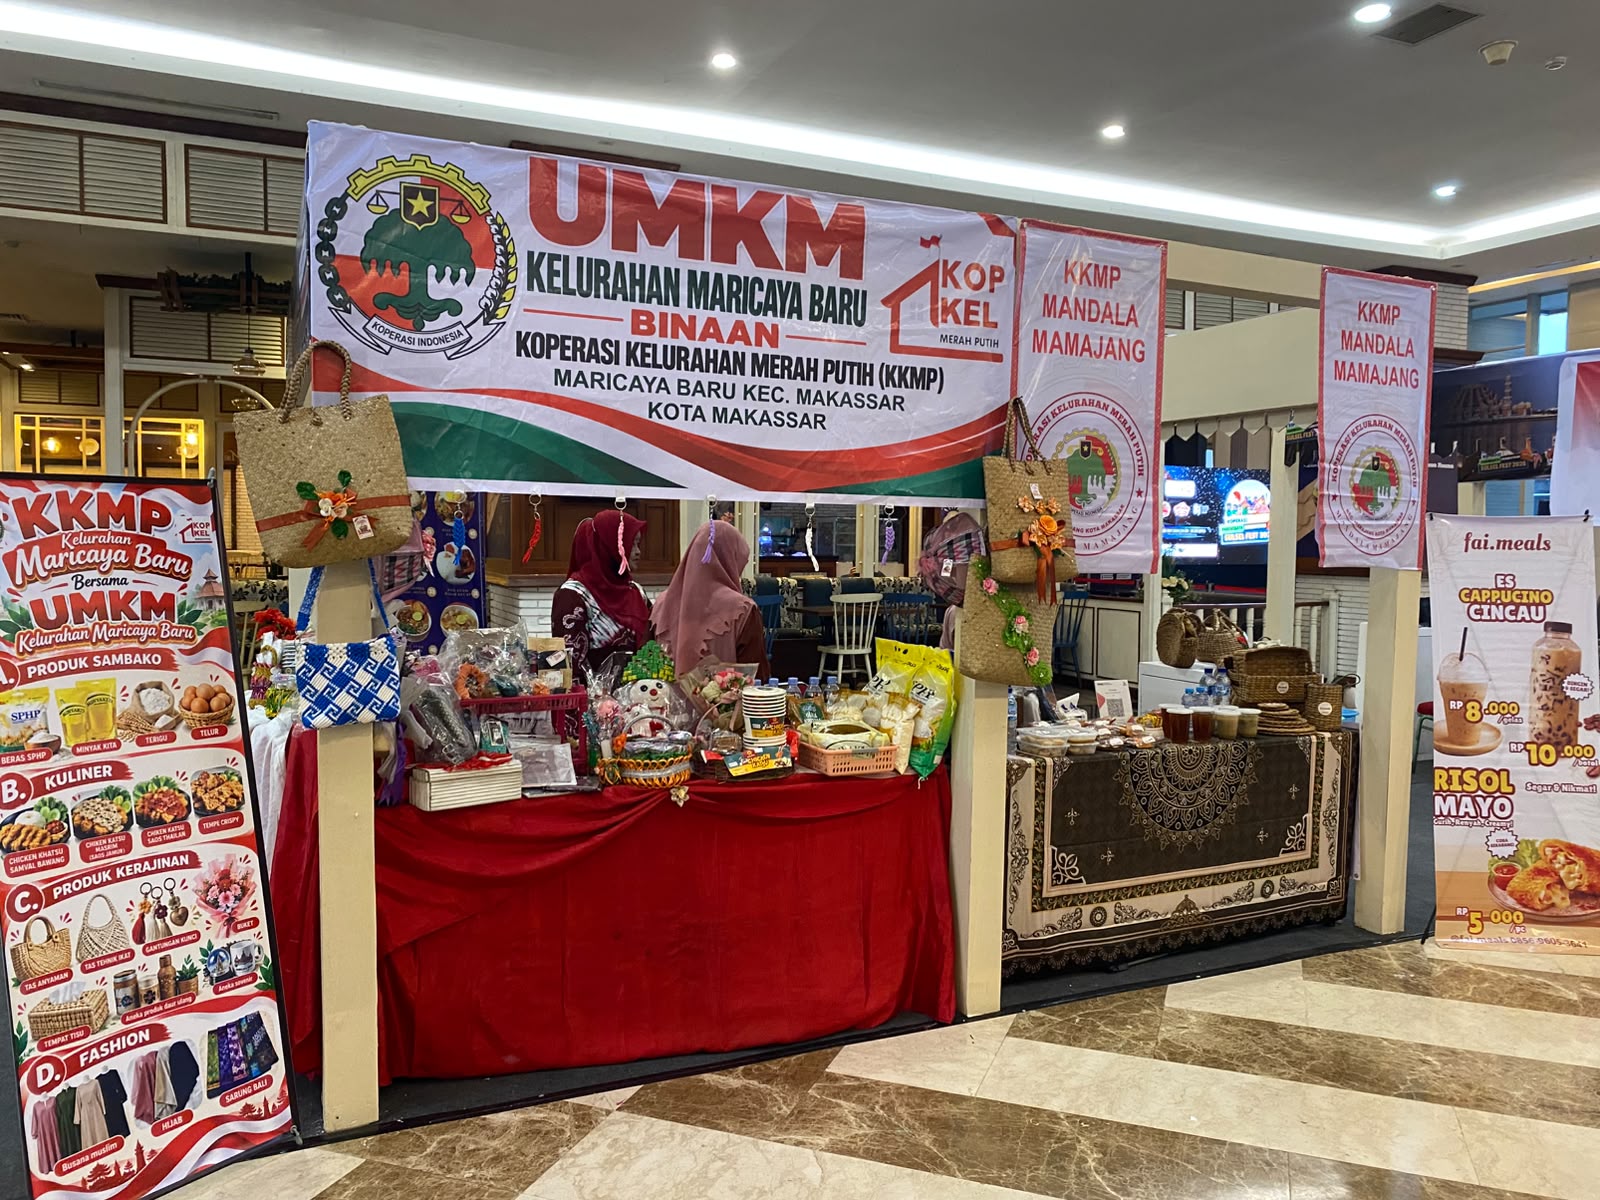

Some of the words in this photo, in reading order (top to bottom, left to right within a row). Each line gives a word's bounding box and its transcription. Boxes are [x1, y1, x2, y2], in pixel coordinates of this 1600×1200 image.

[529, 156, 866, 281] UMKM
[941, 259, 1006, 293] KOP
[1064, 260, 1121, 289] KKMP
[527, 250, 680, 300] KELURAHAN
[687, 269, 801, 320] MARICAYA
[808, 285, 868, 327] BARU
[940, 297, 999, 329] KEL
[1042, 293, 1139, 328] MANDALA
[1357, 300, 1401, 326] KKMP
[371, 321, 415, 346] KOPERASI
[417, 329, 464, 347] INDONESIA
[630, 308, 780, 349] BINAAN
[939, 333, 972, 346] MERAH
[974, 336, 999, 349] PUTIH
[1032, 329, 1146, 363] MAMAJANG
[1341, 329, 1415, 359] MANDALA
[516, 330, 620, 366] KOPERASI
[625, 341, 746, 376] KELURAHAN
[750, 351, 819, 382] MERAH
[823, 358, 875, 387] PUTIH
[879, 362, 945, 394] (KKMP)
[1334, 359, 1419, 389] MAMAJANG
[553, 368, 670, 396] MARICAYA
[676, 378, 736, 401] BARU
[743, 382, 790, 404] KEC.
[796, 388, 905, 412] MAKASSAR
[648, 401, 706, 424] KOTA
[712, 407, 827, 431] MAKASSAR
[1050, 398, 1110, 418] KELURAHAN
[1110, 407, 1137, 441] MERAH
[1133, 441, 1144, 477] PUTIH
[1331, 434, 1352, 482] KOPERASI
[1351, 419, 1393, 436] KELURAHAN
[1394, 428, 1413, 455] MERAH
[12, 489, 172, 540] KKMP
[1083, 506, 1138, 550] MAMAJANG
[61, 532, 131, 550] Kelurahan
[1464, 532, 1551, 552] fai.meals
[15, 545, 128, 585] Maricaya
[135, 543, 189, 575] Baru
[71, 573, 129, 590] Bersama
[1496, 574, 1515, 589] ES
[1460, 588, 1553, 605] CAPPUCINO
[29, 590, 176, 631] UMKM
[1468, 604, 1546, 623] CINCAU
[18, 630, 89, 653] Kelurahan
[92, 625, 157, 643] Maricaya
[160, 622, 195, 640] Baru
[26, 657, 89, 679] PRODUK
[93, 653, 162, 671] SAMBAKO
[11, 709, 41, 722] SPHP
[1450, 701, 1463, 710] RP
[145, 734, 169, 744] TERIGU
[200, 728, 219, 737] TELUR
[76, 744, 102, 753] MINYAK
[102, 742, 118, 750] KITA
[1509, 742, 1524, 752] RP
[1, 754, 26, 765] BERAS
[27, 752, 47, 761] SPHP
[0, 779, 27, 802] B.
[45, 764, 113, 791] KULINER
[1434, 767, 1515, 794] RISOL
[1525, 782, 1552, 793] Segar
[1553, 783, 1561, 792] &
[1561, 783, 1597, 794] Nikmat!
[1433, 794, 1515, 820] MAYO
[168, 825, 185, 833] KATSU
[203, 819, 220, 829] TEMPE
[220, 815, 240, 825] CRISPY
[1484, 820, 1514, 828] Creamy!
[108, 835, 126, 844] KATSU
[163, 831, 186, 841] THAILAN
[8, 853, 36, 866] CHICKEN
[37, 848, 64, 860] KHATSU
[10, 861, 37, 873] SAMVAL
[38, 855, 65, 869] BAWANG
[14, 891, 38, 914] C.
[52, 868, 112, 899] PRODUK
[116, 854, 190, 878] KERAJINAN
[1456, 907, 1468, 916] RP
[236, 920, 254, 930] BUKET
[1509, 923, 1526, 934] /pc
[145, 938, 178, 954] GANTUNGAN
[178, 933, 198, 944] KUNCI
[84, 962, 96, 970] TAS
[118, 952, 132, 961] IKAT
[25, 982, 37, 991] TAS
[37, 972, 69, 987] ANYAMAN
[218, 983, 234, 992] Aneka
[125, 1012, 143, 1022] Aneka
[144, 1006, 164, 1018] produk
[164, 1002, 177, 1010] daur
[177, 996, 193, 1007] ulang
[43, 1034, 69, 1048] TEMPAT
[70, 1031, 84, 1041] TISU
[36, 1062, 60, 1088] D.
[79, 1028, 150, 1068] FASHION
[225, 1085, 252, 1103] SARUNG
[253, 1079, 268, 1090] BALI
[161, 1117, 183, 1131] HIJAB
[61, 1155, 89, 1172] Busana
[90, 1142, 117, 1158] muslim
